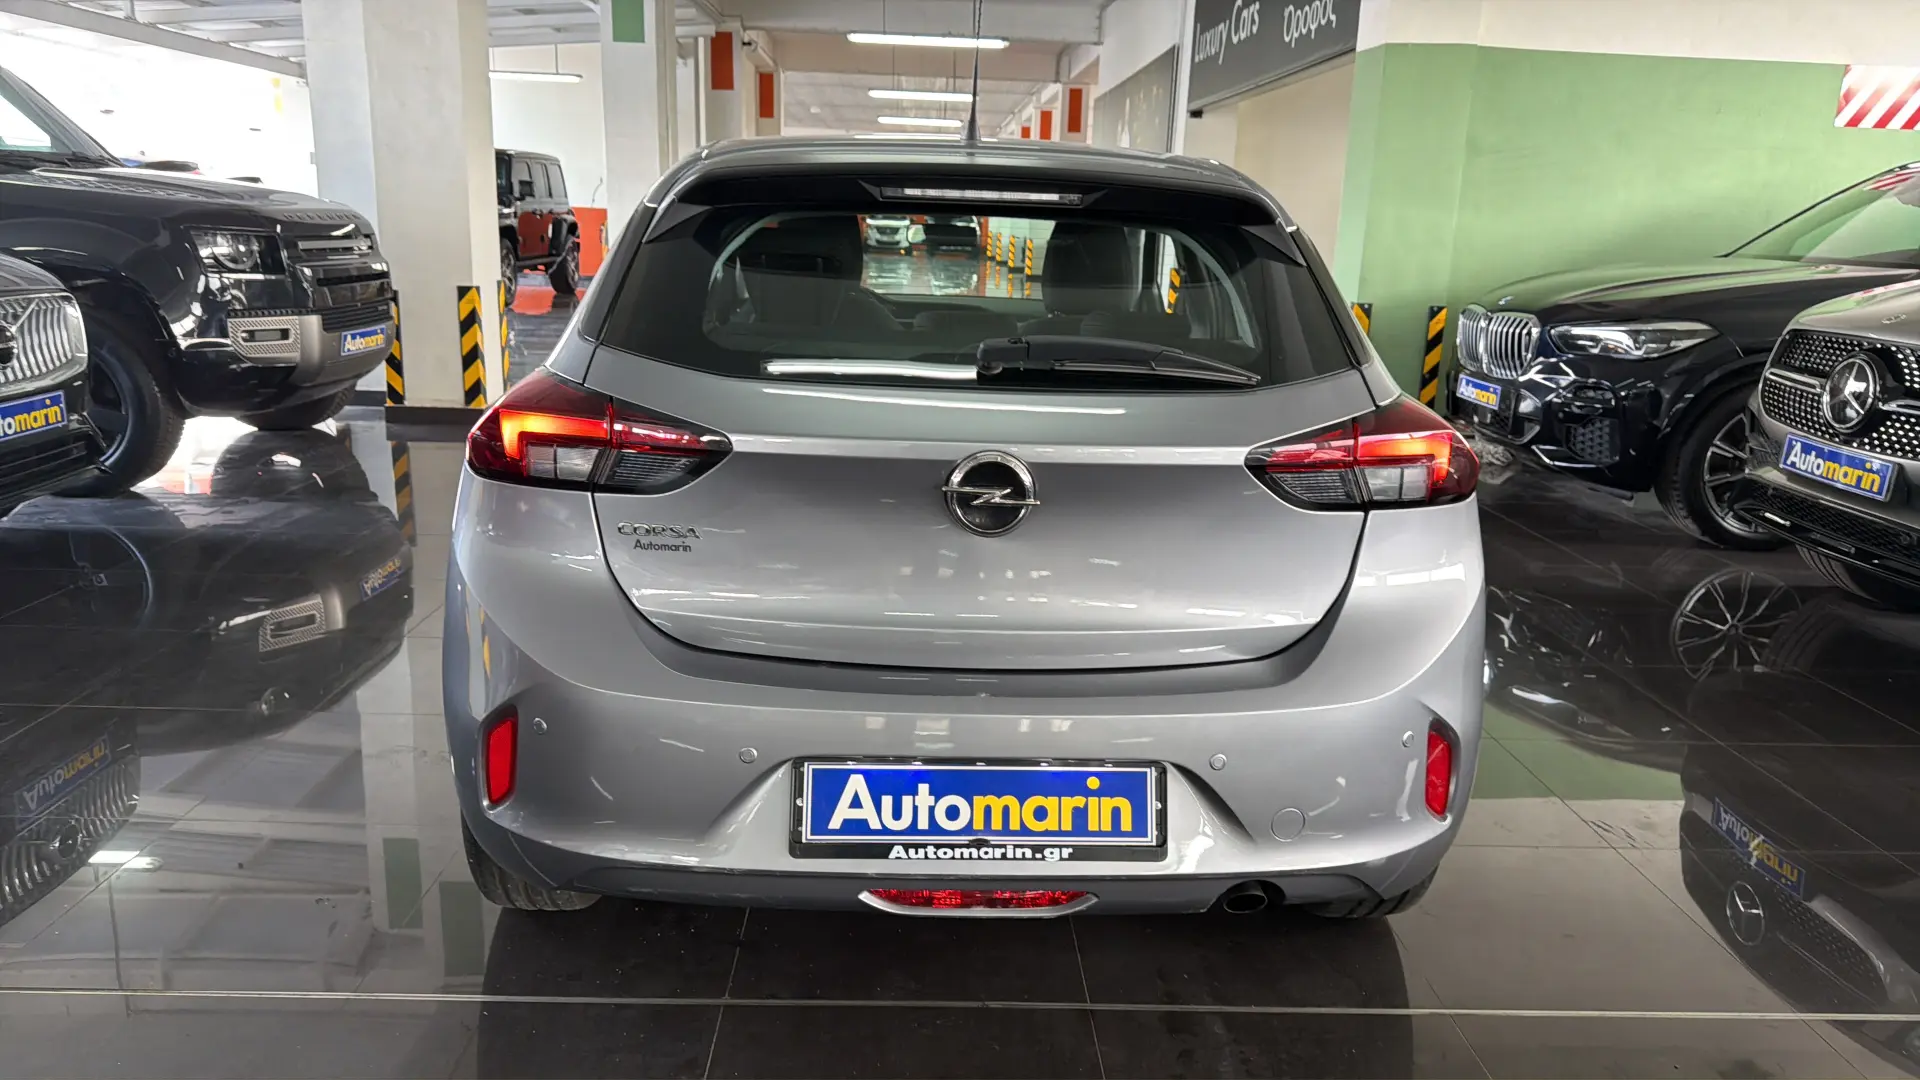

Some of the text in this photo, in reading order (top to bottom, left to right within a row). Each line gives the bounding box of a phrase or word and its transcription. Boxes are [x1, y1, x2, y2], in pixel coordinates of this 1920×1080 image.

[1194, 0, 1260, 65] Luxury Cars
[1786, 440, 1881, 493] Automarin
[617, 522, 703, 540] CORSA
[633, 539, 692, 552] Automarin
[827, 774, 1133, 832] Automarin
[888, 844, 1074, 862] Automarin.gr
